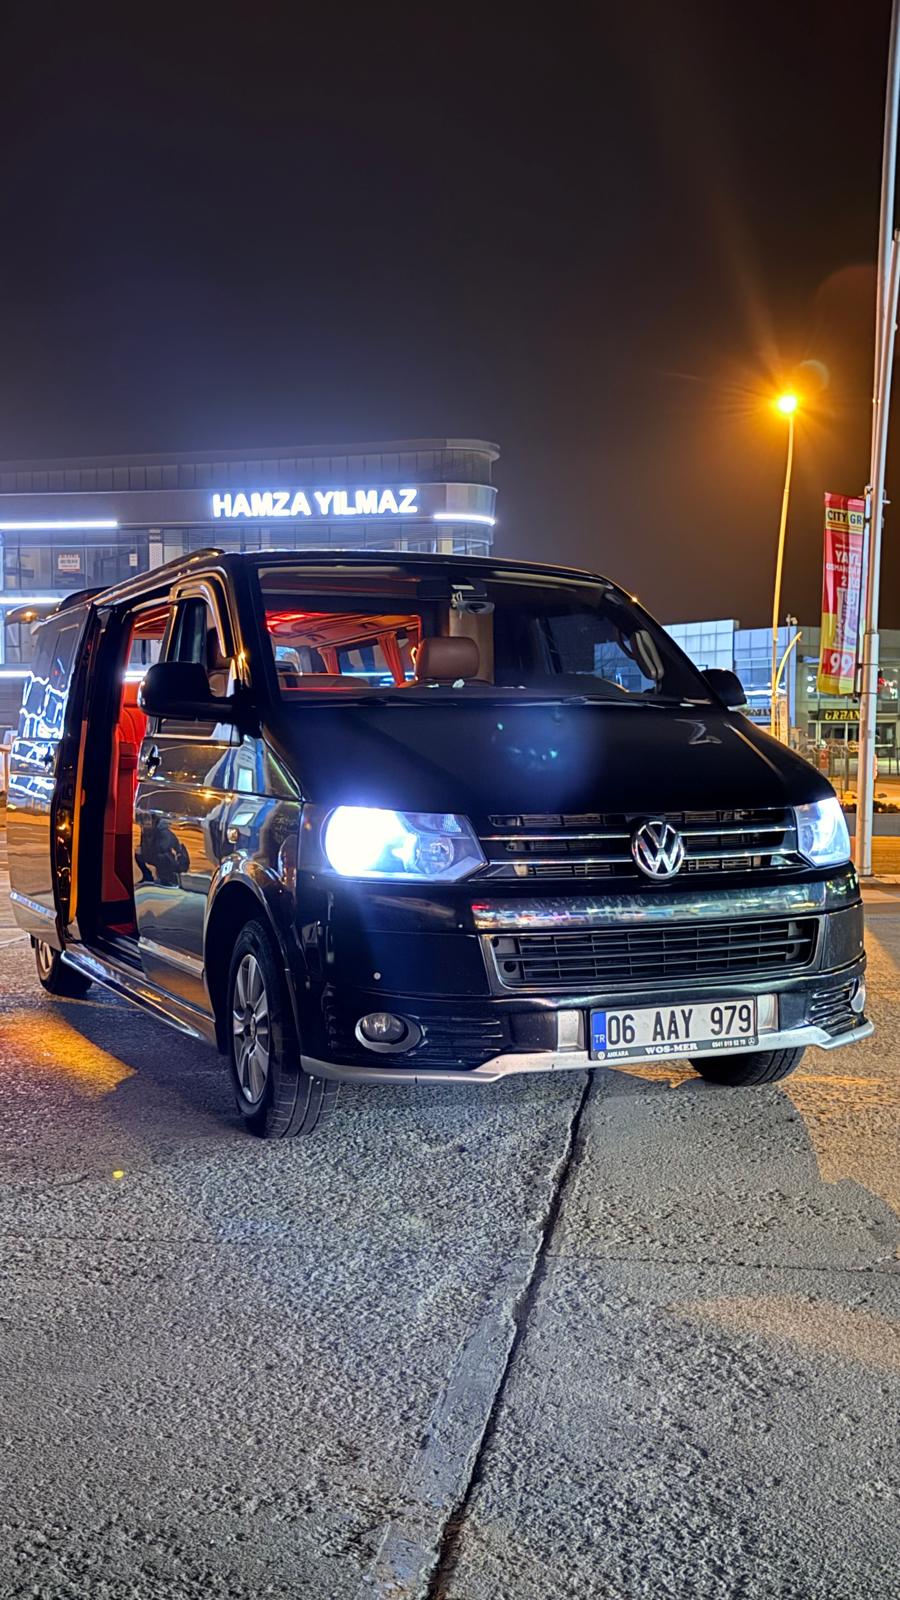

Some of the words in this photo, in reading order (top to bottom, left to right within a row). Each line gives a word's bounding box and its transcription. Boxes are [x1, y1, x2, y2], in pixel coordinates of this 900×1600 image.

[212, 492, 312, 518] HAMZA
[314, 488, 418, 515] YILMAZ
[827, 510, 848, 523] CITY
[830, 653, 853, 675] 99
[607, 1014, 635, 1046] 06
[652, 1008, 693, 1042] AAY
[710, 1004, 751, 1036] 979
[594, 1033, 606, 1044] TR
[606, 1050, 629, 1058] ANKARA
[645, 1043, 698, 1055] WOS-MER
